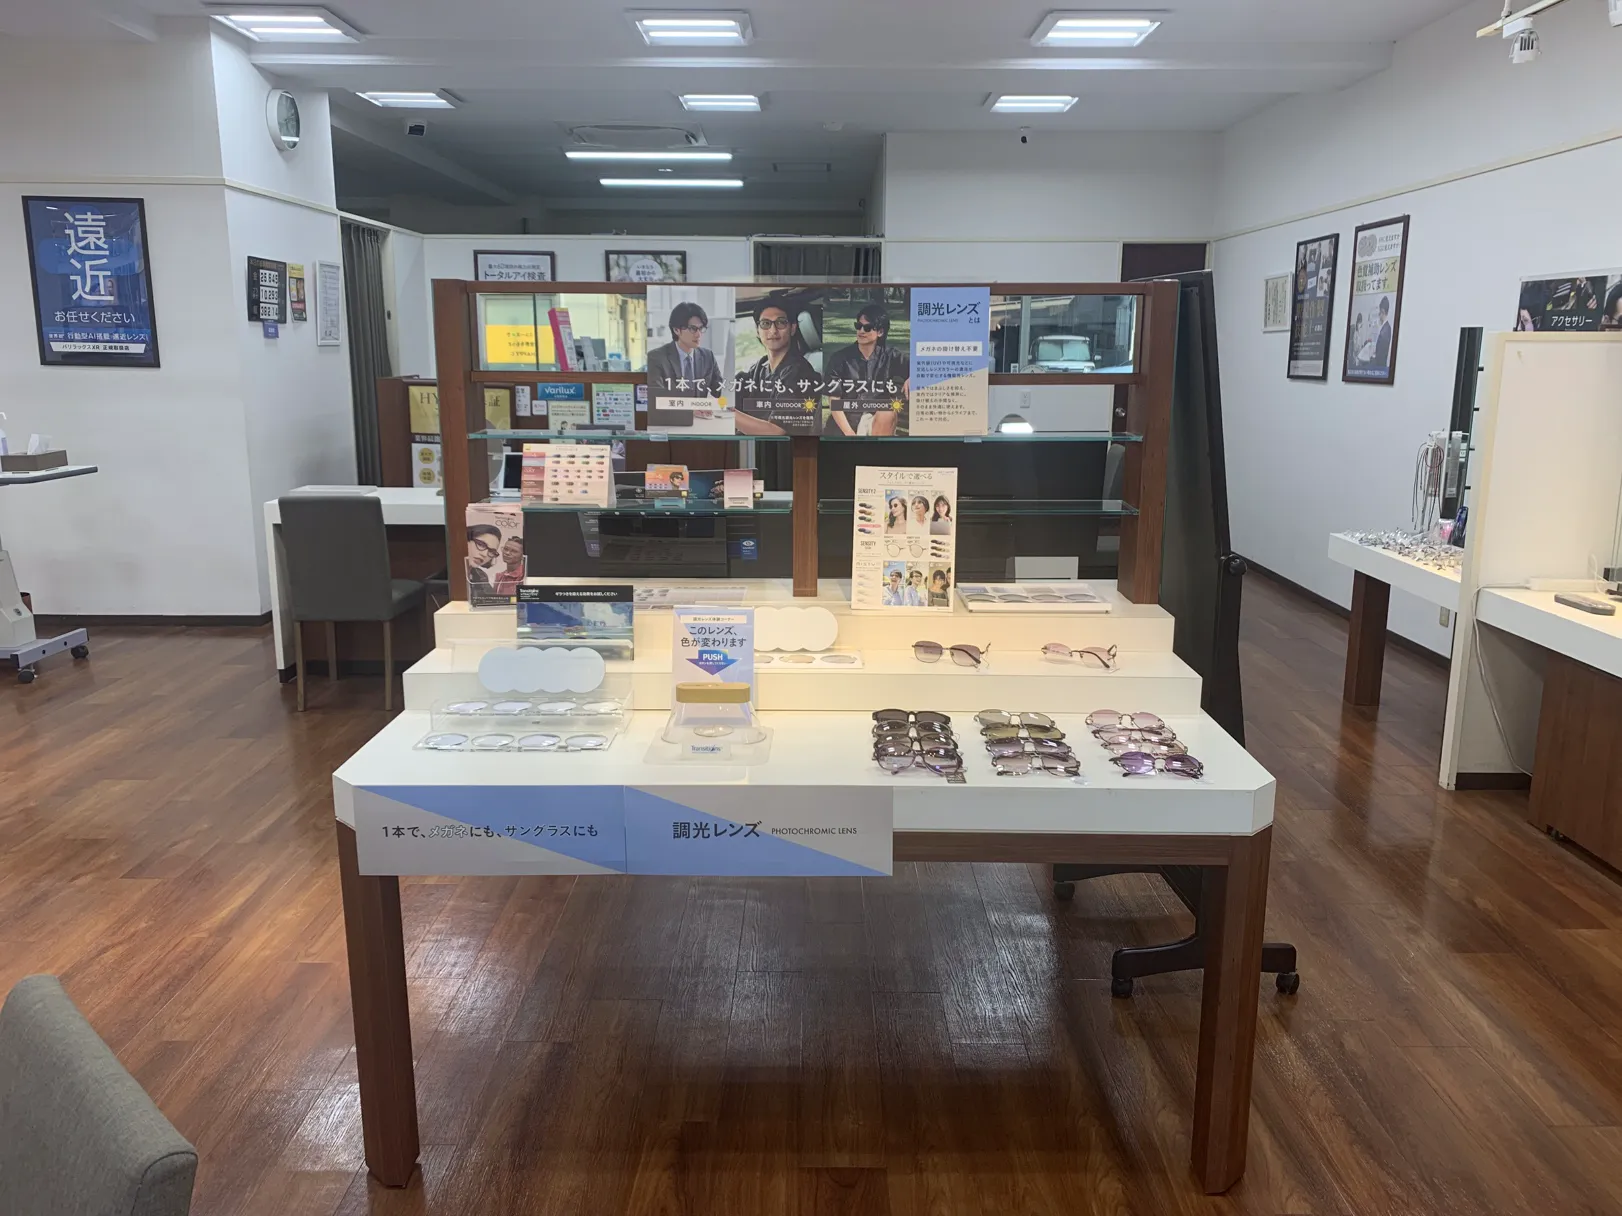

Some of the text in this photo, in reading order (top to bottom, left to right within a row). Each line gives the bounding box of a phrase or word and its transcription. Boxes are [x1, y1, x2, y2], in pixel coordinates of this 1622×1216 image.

[484, 270, 546, 281] トータルアイ検査
[917, 301, 982, 316] 調光レンズ
[54, 310, 136, 324] お任せください
[968, 316, 981, 324] とは
[1550, 315, 1593, 327] アクセサリー
[544, 386, 576, 395] Varilux
[664, 377, 898, 394] 1本で、メガネにも、サングラスにも
[668, 399, 684, 407] 室内
[755, 400, 772, 409] 車内
[842, 401, 859, 409] 屋外
[879, 471, 933, 480] スタイルで選べる
[688, 625, 738, 636] このレンズ、
[681, 637, 747, 648] 色が変わります
[702, 653, 724, 661] PUSH
[381, 825, 599, 839] 1本で、メガネにも、サングラスにも
[672, 820, 858, 840] 調光レンズ PHOTOCHROMIC LENS
